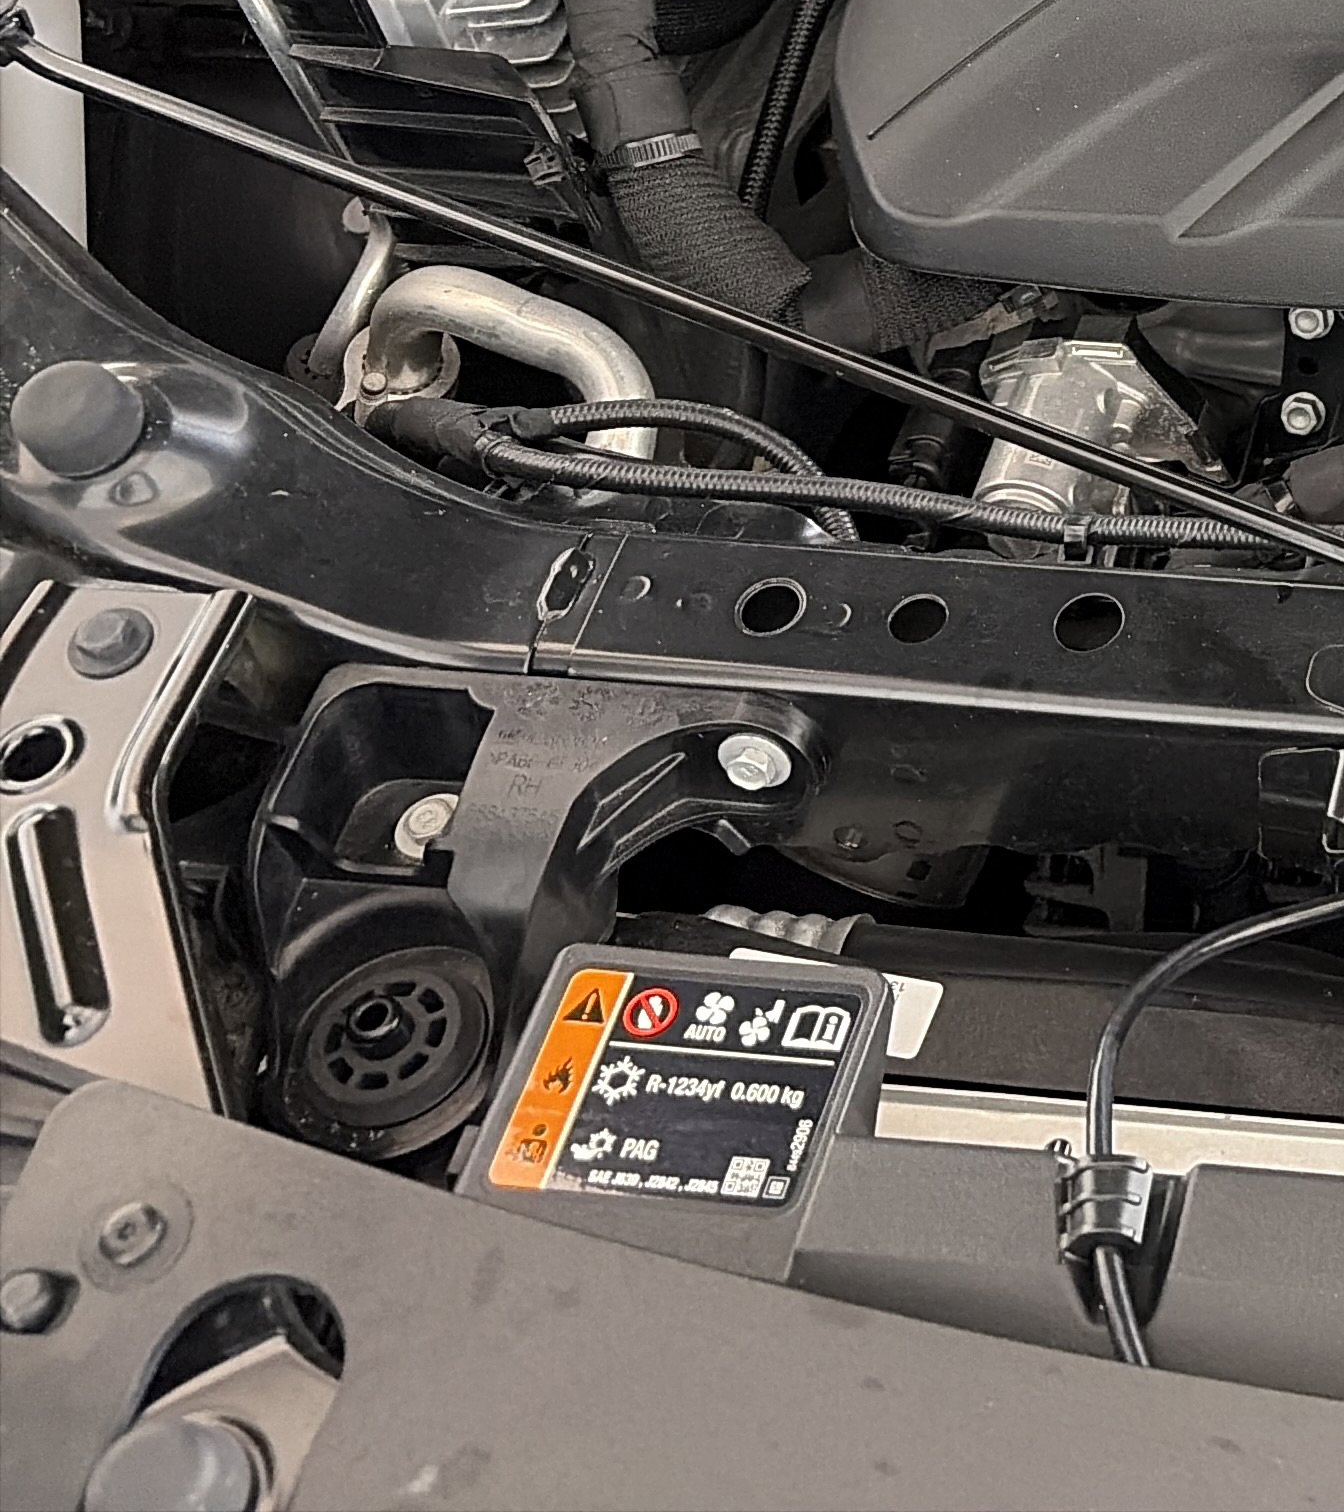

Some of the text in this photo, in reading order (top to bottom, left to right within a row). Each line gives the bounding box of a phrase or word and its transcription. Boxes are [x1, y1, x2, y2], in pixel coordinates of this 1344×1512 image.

[683, 1023, 726, 1043] AUTO
[645, 1074, 805, 1110] R-1234yf 0.600 kg
[619, 1138, 660, 1161] PAG
[587, 1169, 612, 1185] SAE
